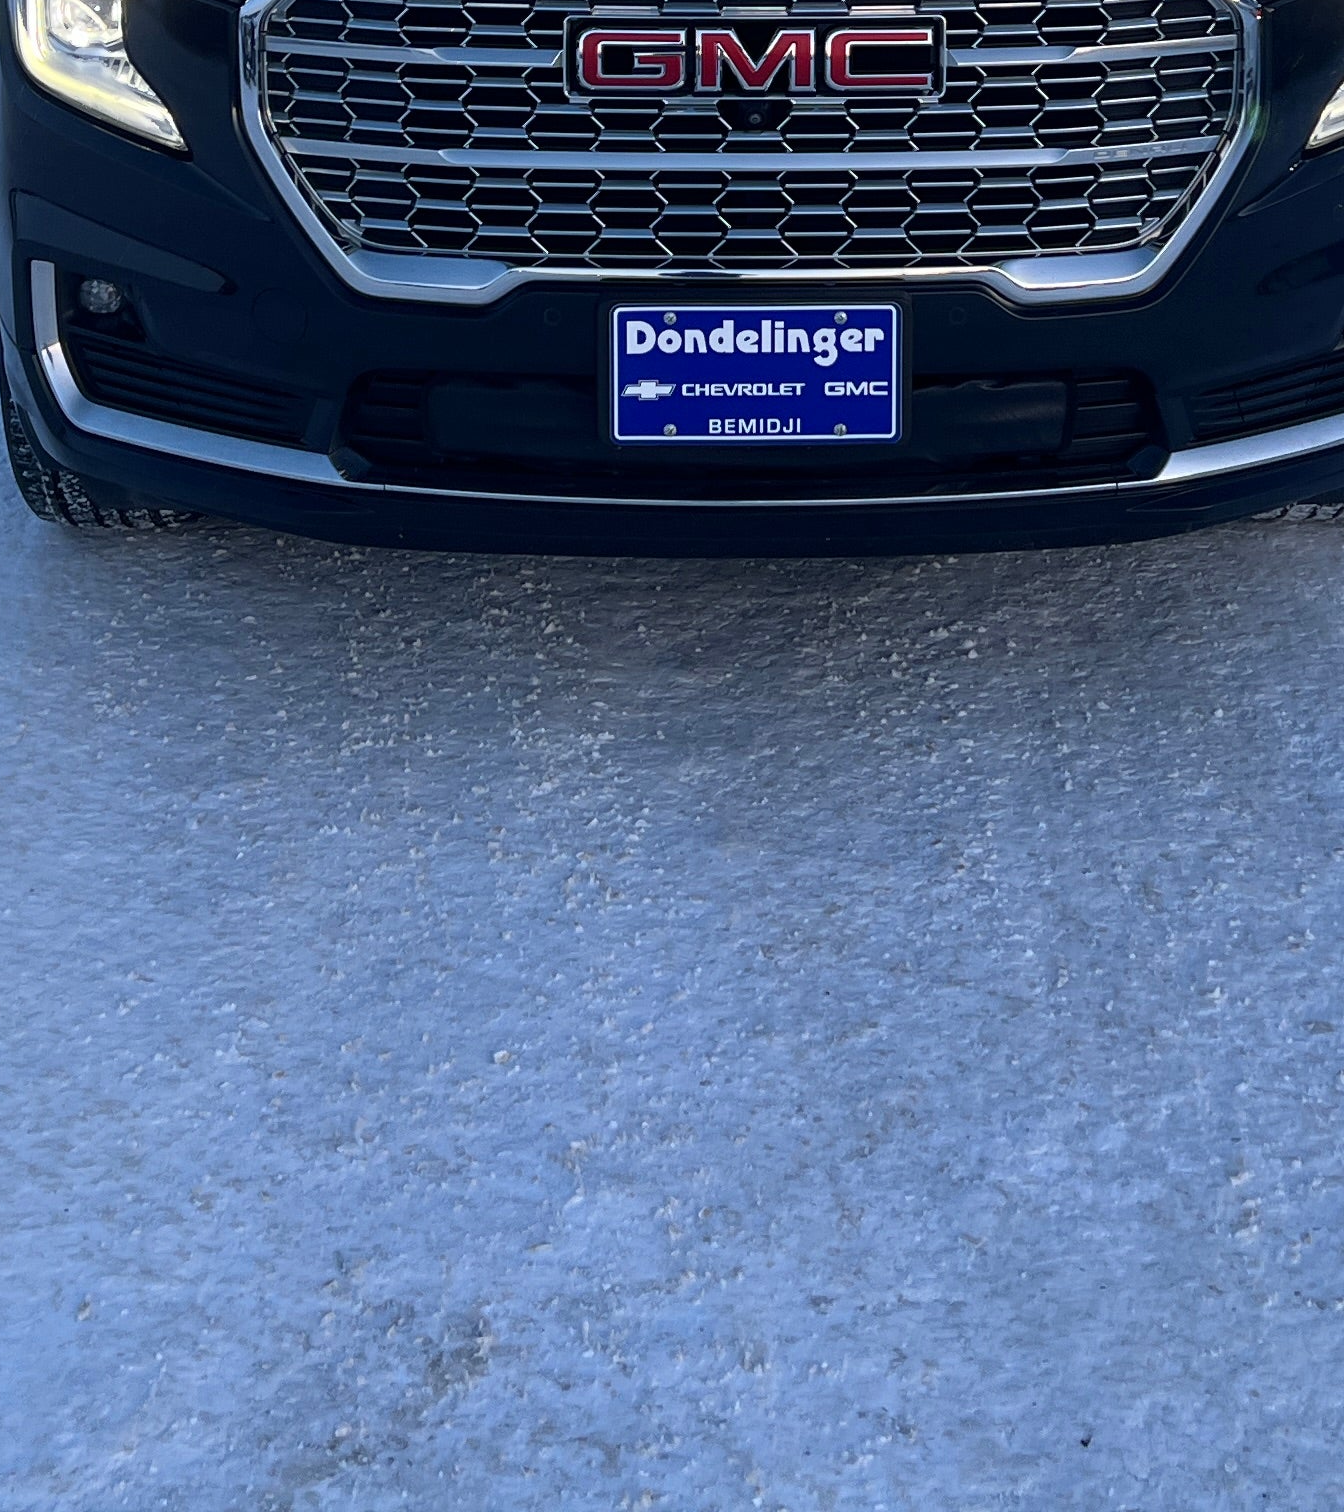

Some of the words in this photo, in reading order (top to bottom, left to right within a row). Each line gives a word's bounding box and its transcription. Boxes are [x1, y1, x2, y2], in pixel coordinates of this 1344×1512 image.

[577, 27, 934, 92] GMC
[626, 319, 885, 367] Dondelinger
[681, 382, 806, 397] CHEVROLET
[823, 381, 889, 396] GMC
[708, 417, 802, 435] BEMIDJI
